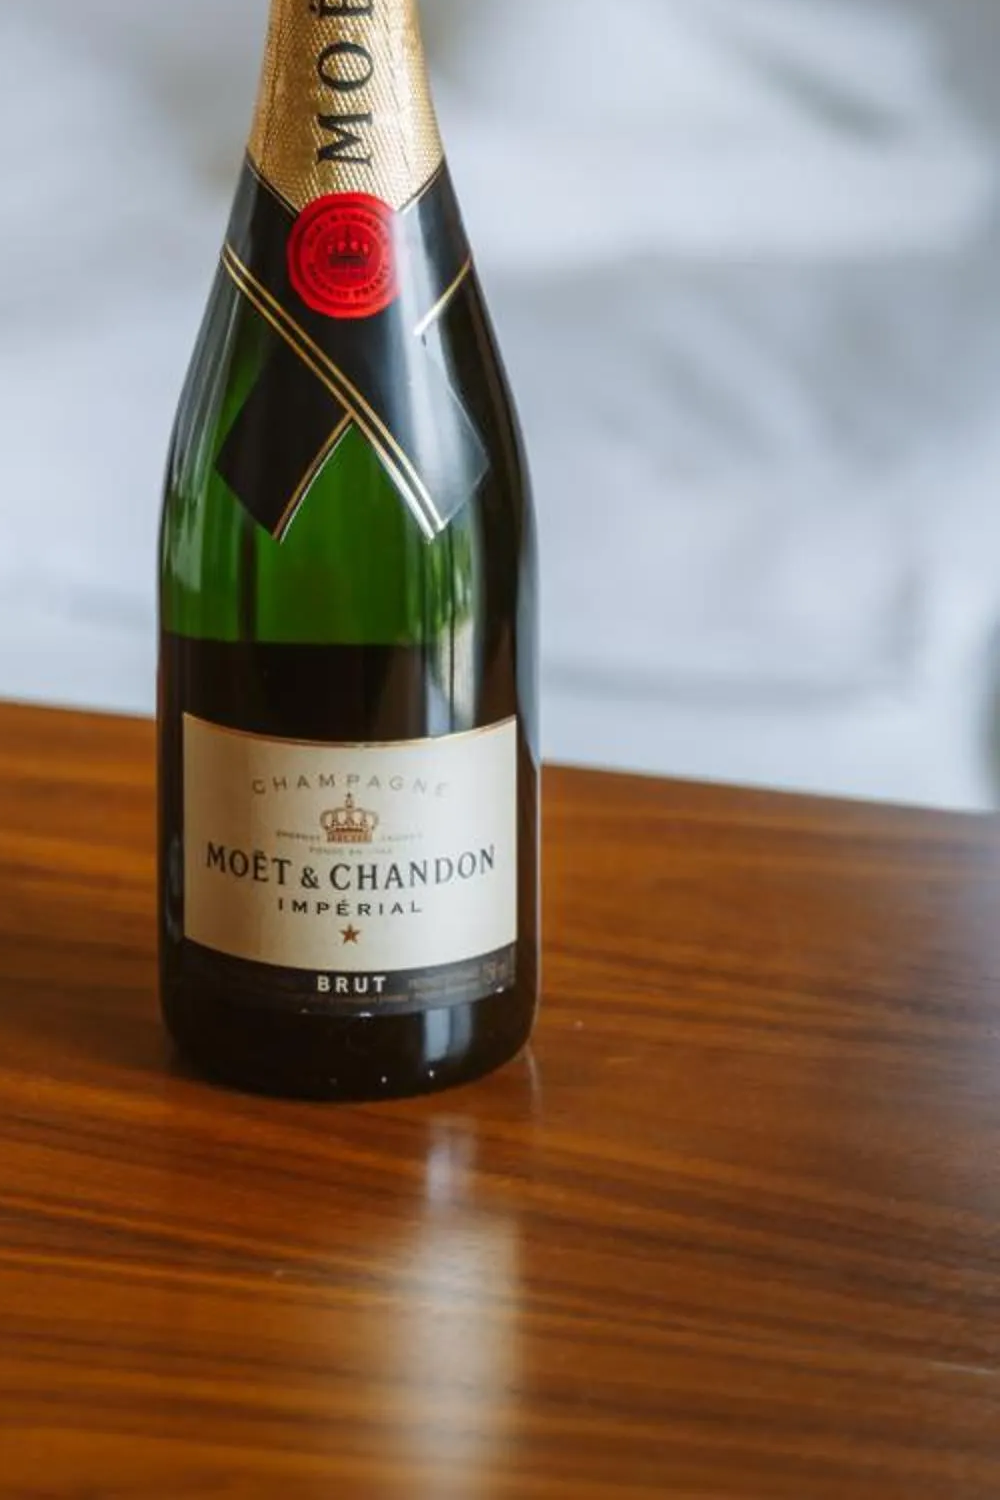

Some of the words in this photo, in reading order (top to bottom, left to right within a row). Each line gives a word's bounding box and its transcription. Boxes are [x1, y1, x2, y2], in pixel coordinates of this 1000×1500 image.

[252, 774, 448, 797] CHAMPAGNE
[206, 841, 292, 885] MOËT
[301, 866, 320, 890] &
[329, 843, 497, 891] CHANDON
[278, 897, 423, 917] IMPÉRIAL
[317, 976, 388, 994] BRUT
